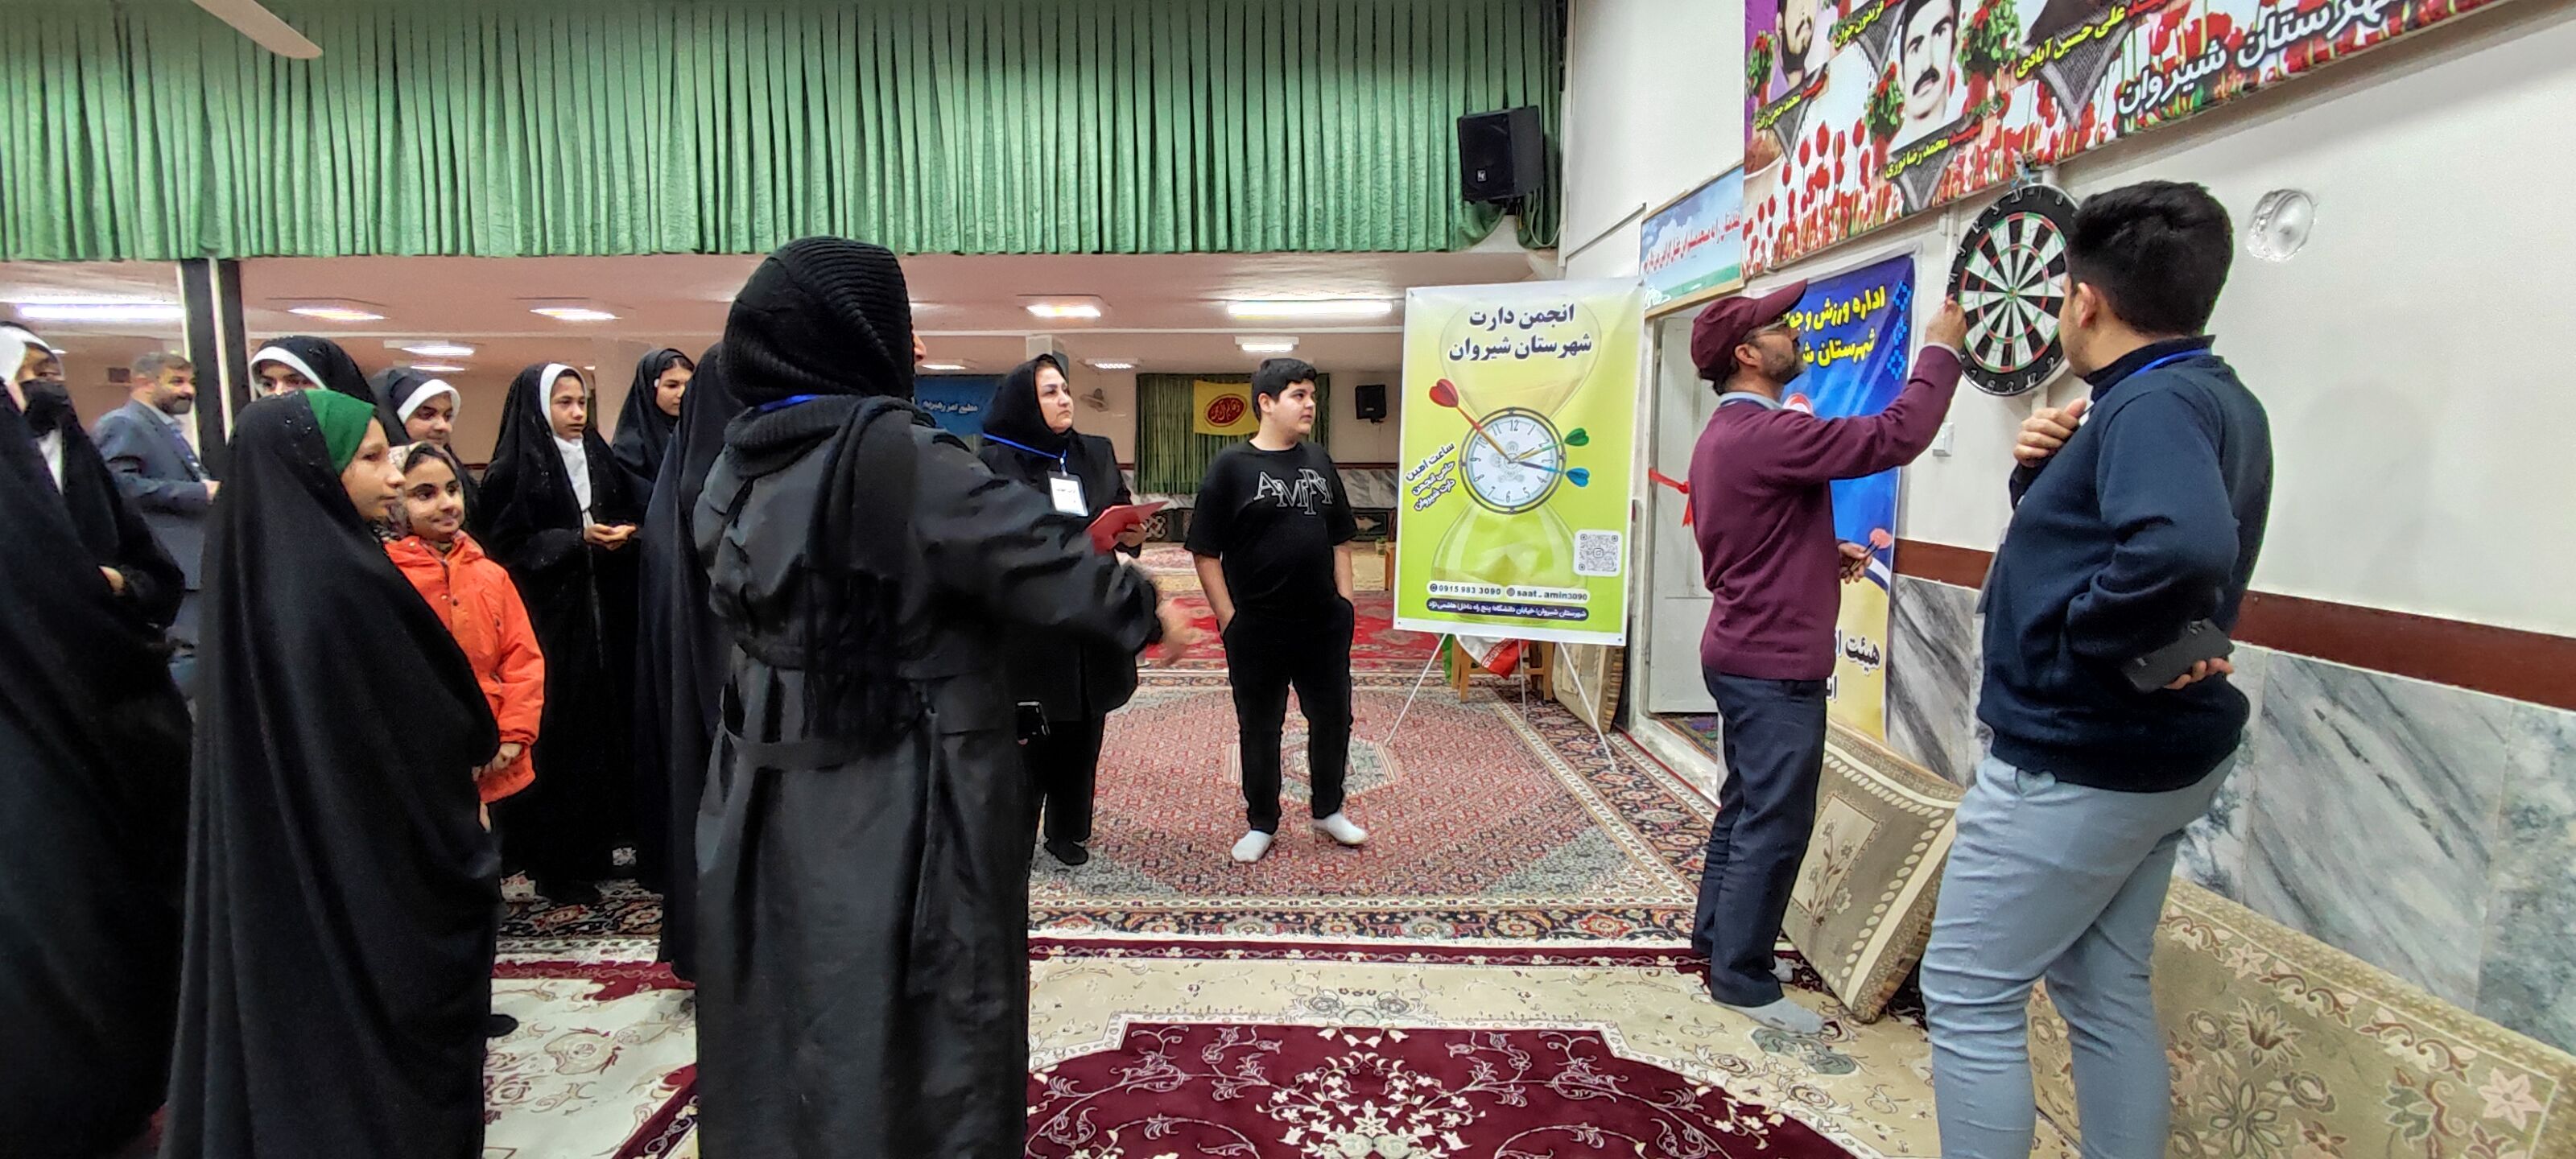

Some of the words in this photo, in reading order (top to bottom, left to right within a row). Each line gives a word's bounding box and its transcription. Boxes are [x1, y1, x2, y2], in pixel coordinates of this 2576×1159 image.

[2095, 6, 2126, 39] علی
[2054, 26, 2093, 60] حسین
[2016, 37, 2053, 78] آبادی
[2118, 39, 2227, 114] شیروان
[1813, 297, 1849, 331] ورزش
[1853, 286, 1886, 320] اداره
[1469, 307, 1514, 332] دارت
[1518, 303, 1574, 330] انجمن
[1805, 311, 1812, 332] و
[1449, 336, 1512, 361] شیروان
[1514, 333, 1592, 359] شهرستان
[1818, 328, 1876, 367] شهرستان
[1491, 423, 1502, 436] 11
[1509, 419, 1519, 431] 12
[1527, 424, 1536, 435] 1
[1429, 443, 1455, 464] ساعت
[1476, 436, 1488, 448] 10
[1538, 439, 1550, 448] 2
[1406, 460, 1429, 481] امین
[1414, 488, 1441, 511] شیروان
[1487, 486, 1496, 497] 7
[1505, 490, 1511, 503] 6
[1522, 487, 1531, 498] 5
[1439, 584, 1459, 592] 0915
[1845, 636, 1880, 673] هیئت
